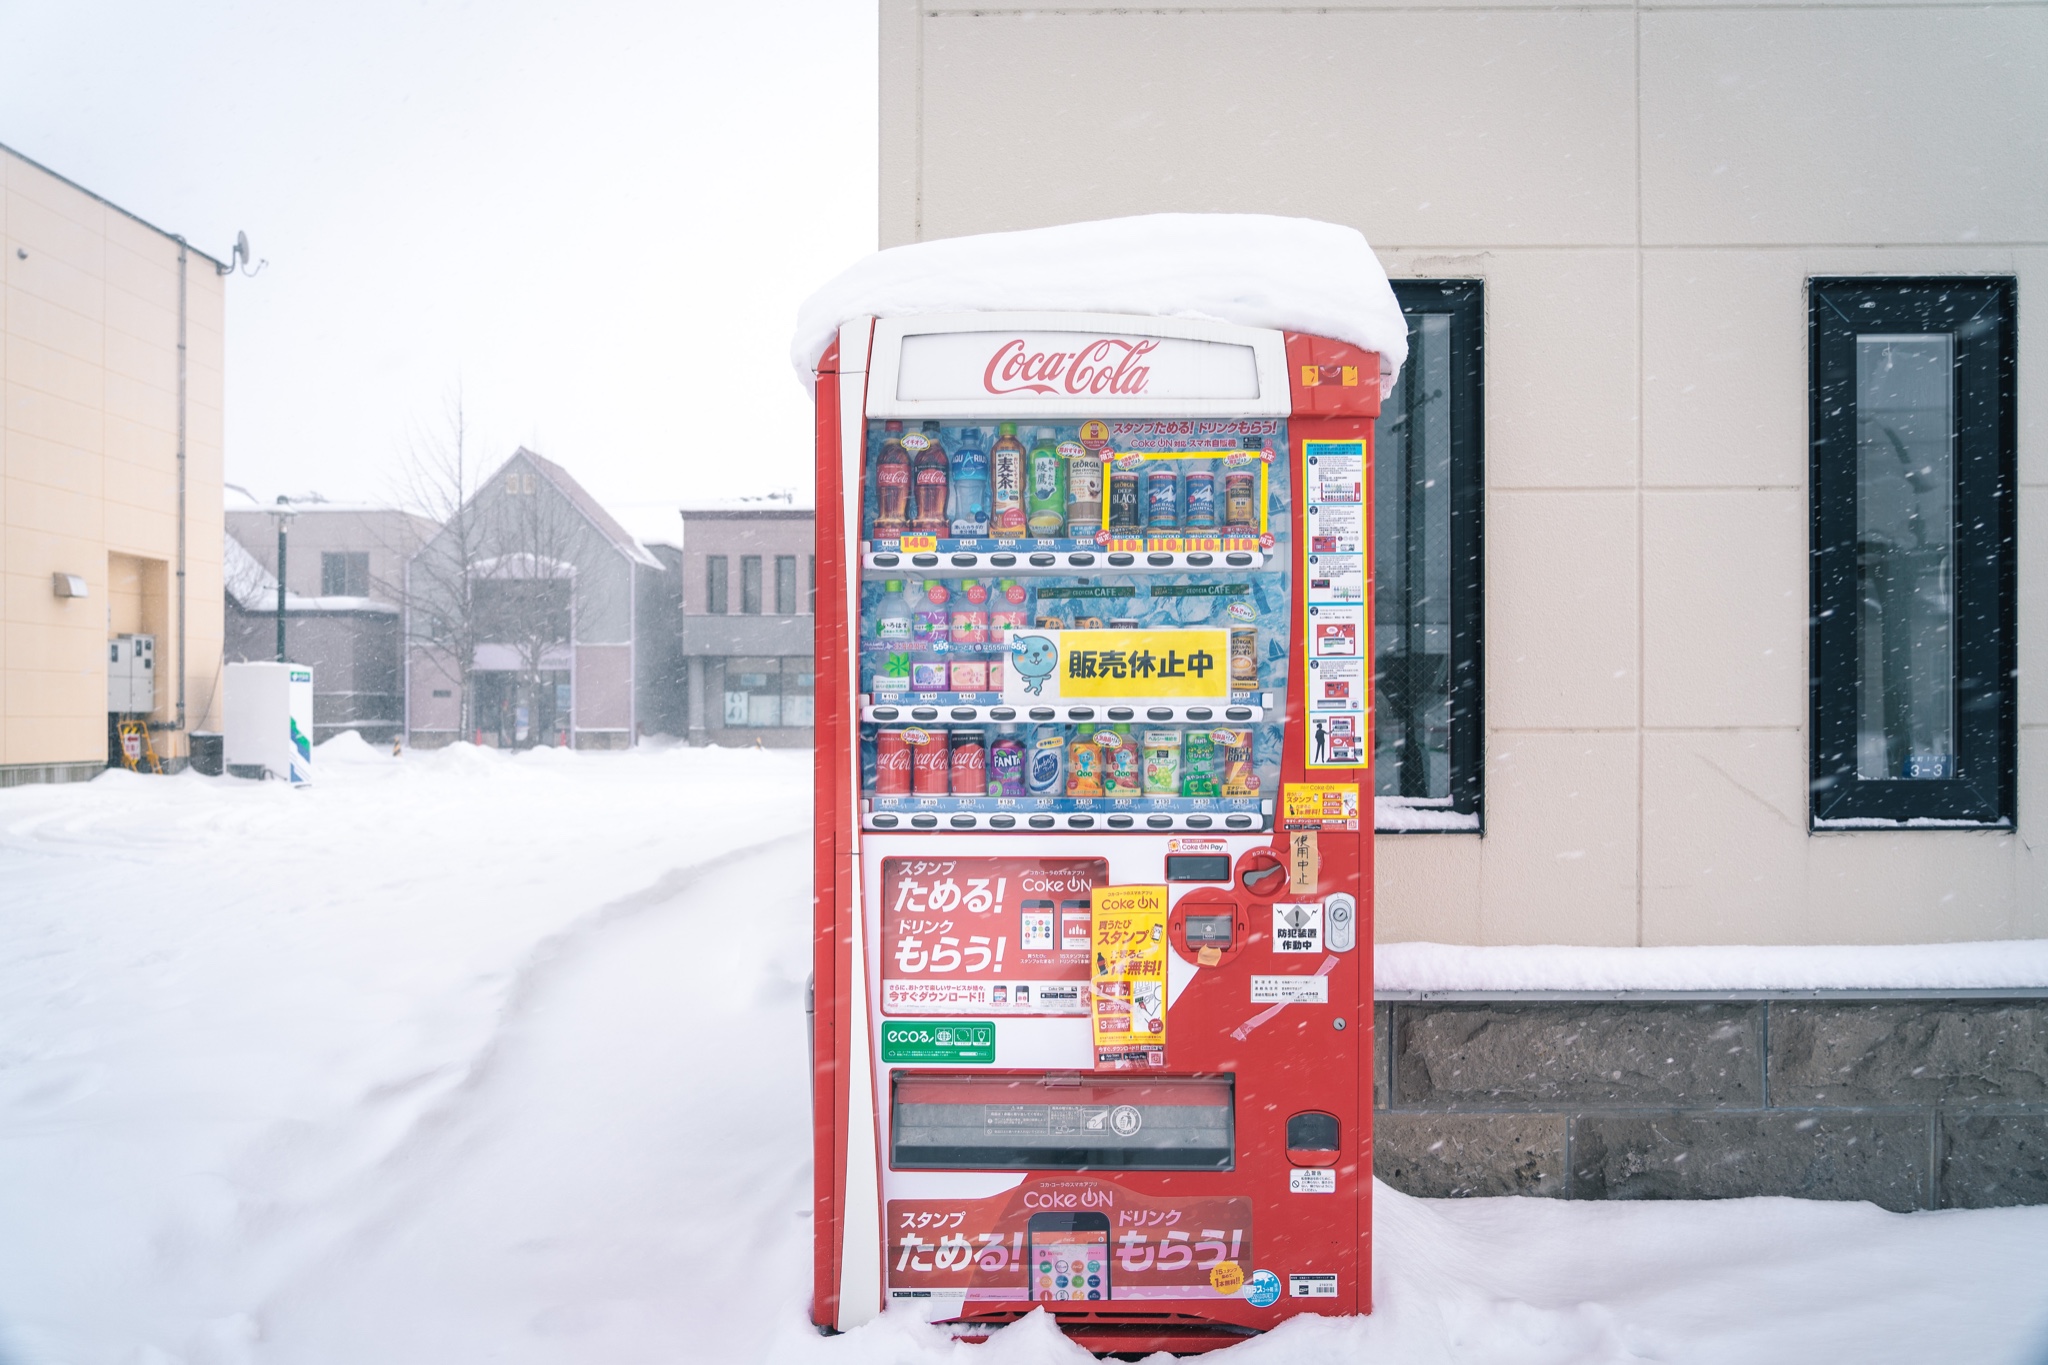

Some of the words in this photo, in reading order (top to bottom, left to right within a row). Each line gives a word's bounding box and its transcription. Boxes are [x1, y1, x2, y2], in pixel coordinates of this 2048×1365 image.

[983, 339, 1160, 396] Coca-Cola
[1112, 420, 1194, 435] スタンプためる!
[1198, 420, 1278, 435] ドリンクもらう!
[1130, 439, 1156, 448] Coke
[997, 457, 1013, 490] 麦茶
[1112, 494, 1137, 505] BLACK
[1094, 588, 1117, 597] CAFE
[1207, 586, 1231, 595] CAFE
[1069, 650, 1214, 679] 販売休止中
[994, 755, 1021, 768] FANTA
[1227, 753, 1250, 762] GOLD
[1076, 770, 1093, 778] Qoo
[1114, 770, 1131, 778] Qoo
[1910, 763, 1943, 777] 3-3
[1294, 834, 1310, 885] 使用中止
[899, 860, 957, 876] スタンプ
[1022, 878, 1064, 892] Coke
[893, 876, 1007, 914] ためる!
[1101, 898, 1135, 910] Coke
[898, 919, 954, 935] ドリンク
[1098, 919, 1132, 931] 買うたび
[1097, 929, 1150, 946] スタンプ
[1277, 928, 1317, 939] 防犯装置
[1282, 940, 1312, 950] 作動中
[894, 935, 1007, 973] もらう!
[1110, 960, 1162, 976] 1本無料!
[888, 991, 986, 1003] 今すぐダウンロード!!
[1099, 1002, 1105, 1010] 2
[1100, 1020, 1107, 1029] 3
[1023, 1191, 1077, 1209] Coke
[1081, 1187, 1114, 1209] ON
[900, 1210, 967, 1229] スタンプ
[1118, 1209, 1182, 1228] ドリンク
[895, 1231, 1024, 1273] ためる!
[1115, 1229, 1244, 1273] もらう!
[1214, 1277, 1241, 1289] 1本無料!!
